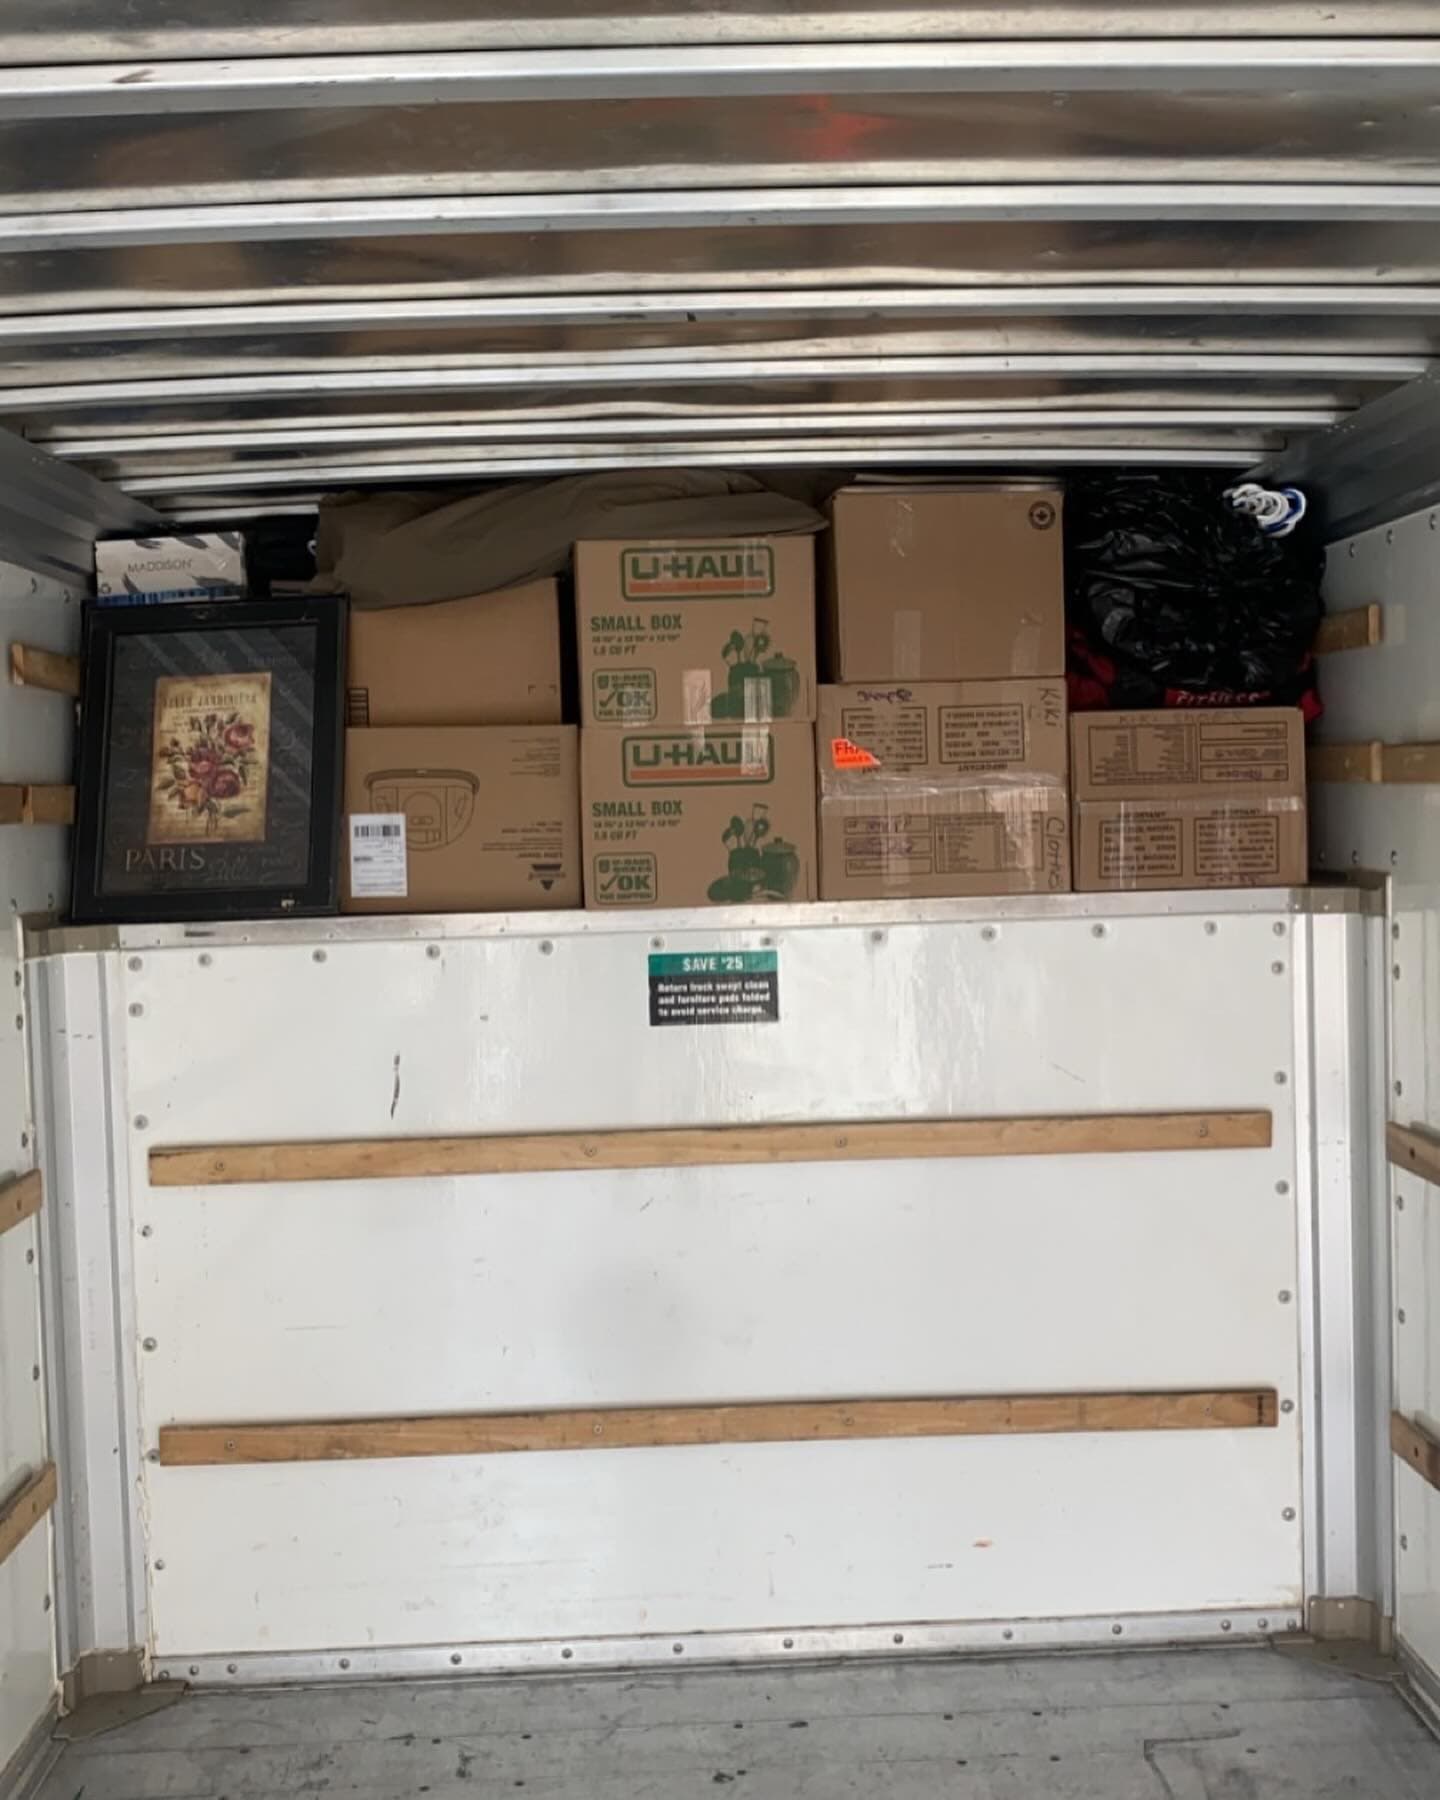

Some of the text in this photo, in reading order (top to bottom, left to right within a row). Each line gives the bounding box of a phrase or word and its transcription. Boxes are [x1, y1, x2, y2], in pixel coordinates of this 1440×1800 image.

[127, 559, 193, 573] MADDISON
[631, 555, 765, 580] U-HAUL
[590, 612, 682, 633] SMALL BOX
[591, 799, 683, 818] SMALL BOX
[125, 847, 206, 873] PARIS
[617, 874, 651, 891] OK
[682, 957, 717, 973] SAVE
[657, 980, 770, 993] Return truck swept clean
[657, 992, 771, 1005] and furniture pads folded
[657, 1007, 669, 1017] to
[671, 1006, 696, 1016] avoid
[696, 1006, 730, 1016] service
